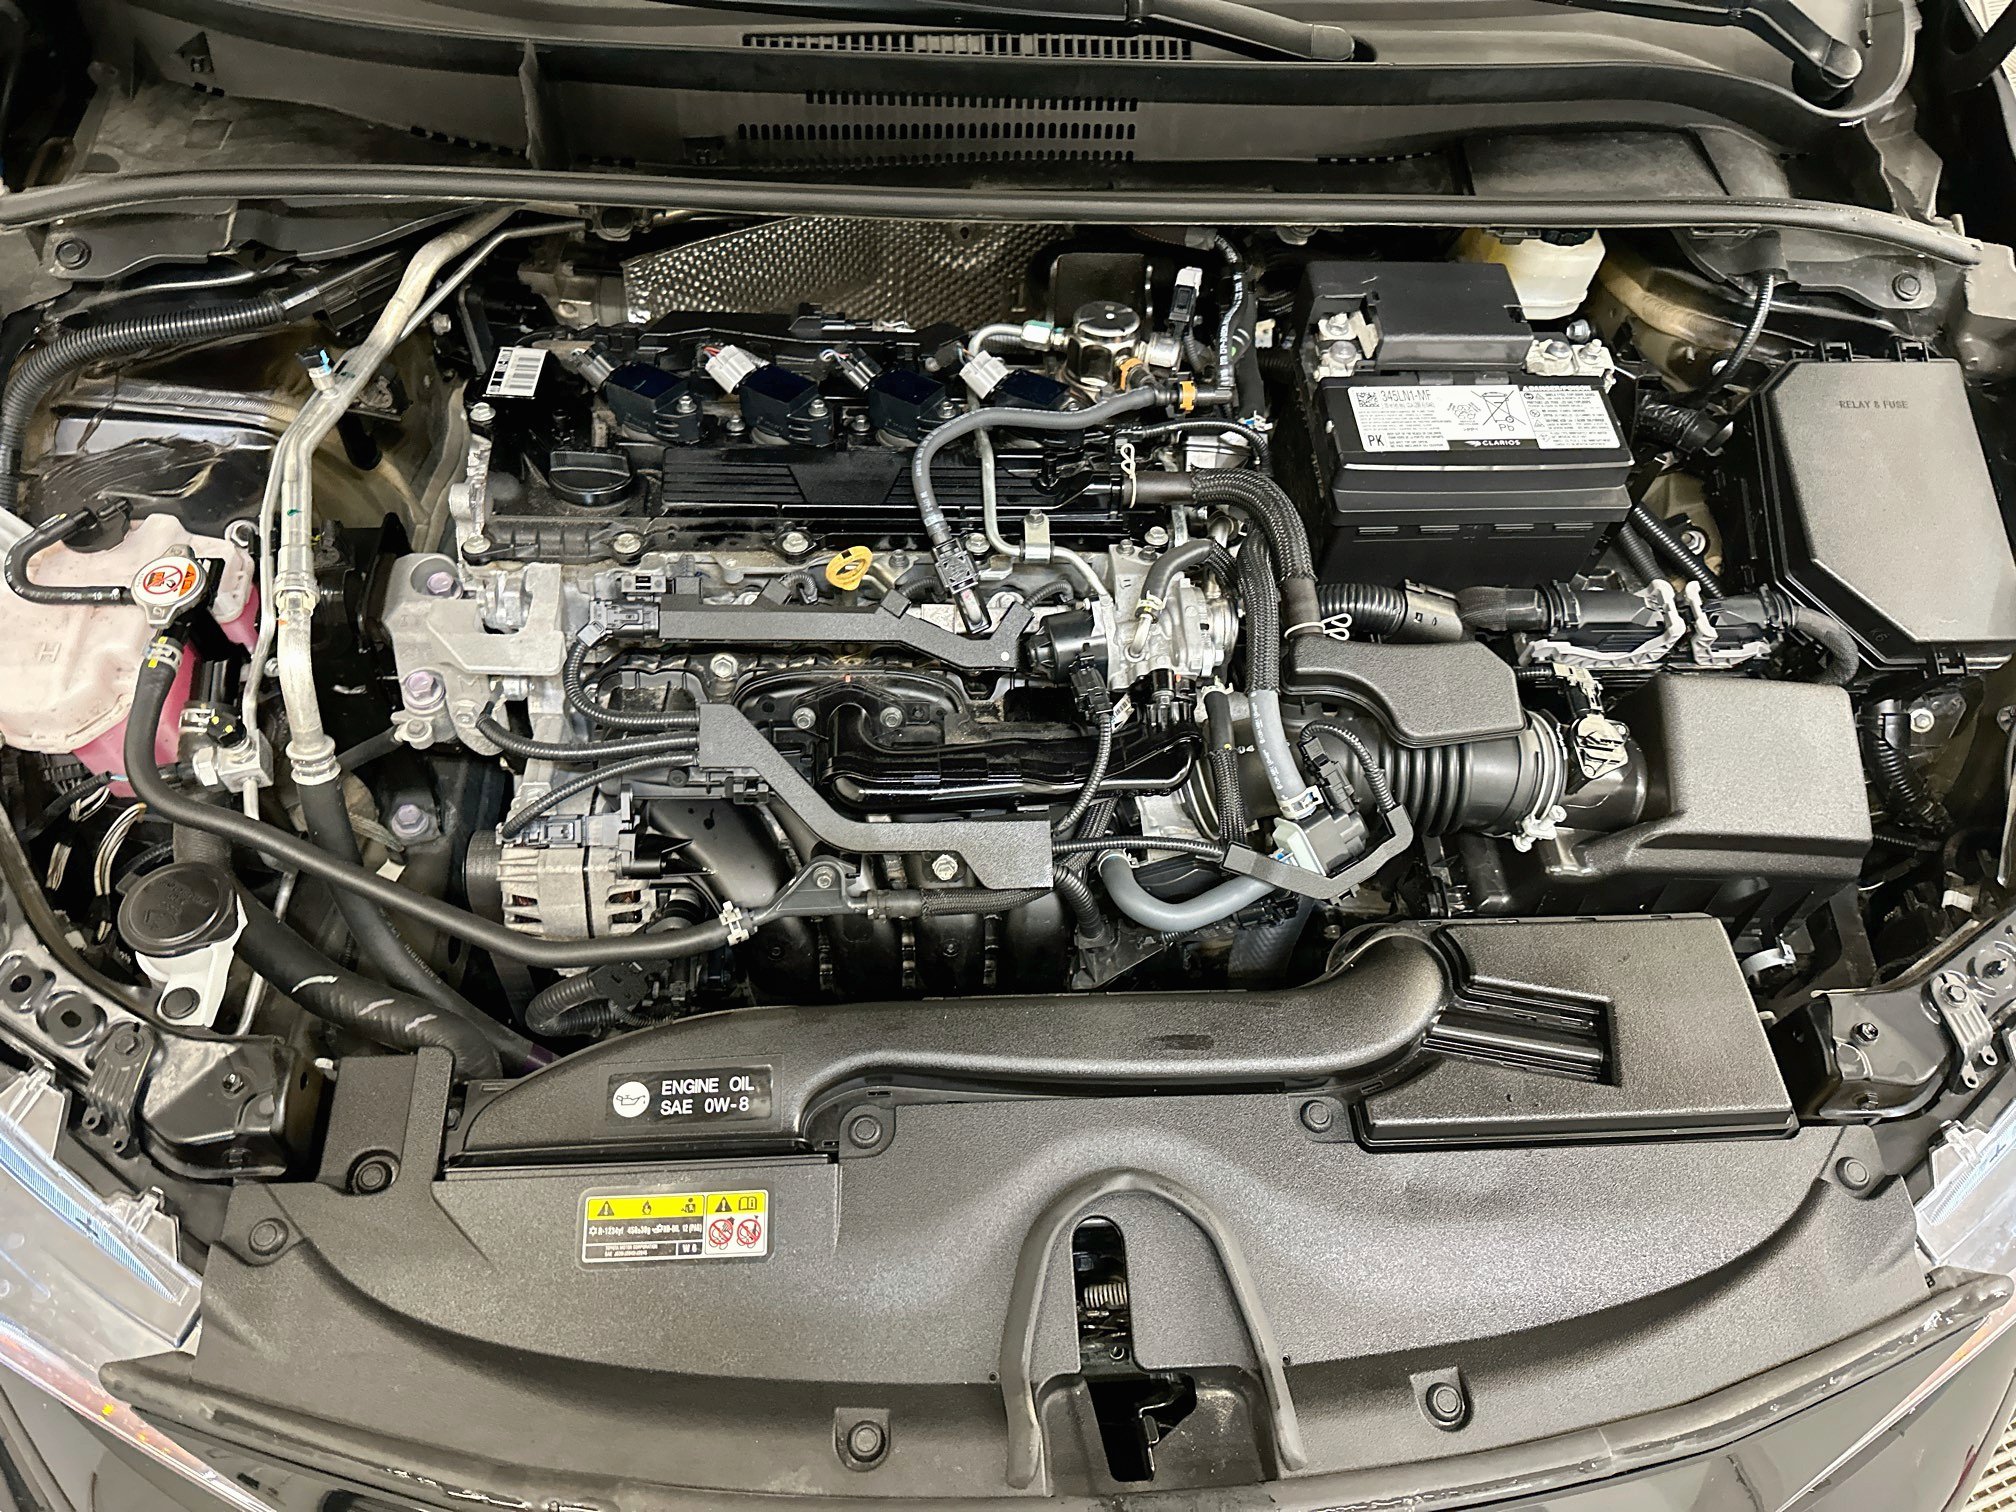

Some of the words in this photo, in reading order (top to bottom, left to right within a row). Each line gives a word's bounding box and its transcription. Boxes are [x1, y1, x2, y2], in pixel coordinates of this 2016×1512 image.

[1380, 389, 1432, 402] 345LN1-MF
[1838, 400, 1871, 409] RELAY
[1873, 400, 1881, 409] &
[1882, 400, 1909, 409] FUSE
[1498, 423, 1515, 432] Pb
[1367, 434, 1385, 447] PK
[661, 1078, 719, 1096] ENGINE
[729, 1076, 755, 1092] OIL
[660, 1099, 693, 1115] SAE
[704, 1096, 750, 1114] 0W-8
[682, 1244, 691, 1253] W
